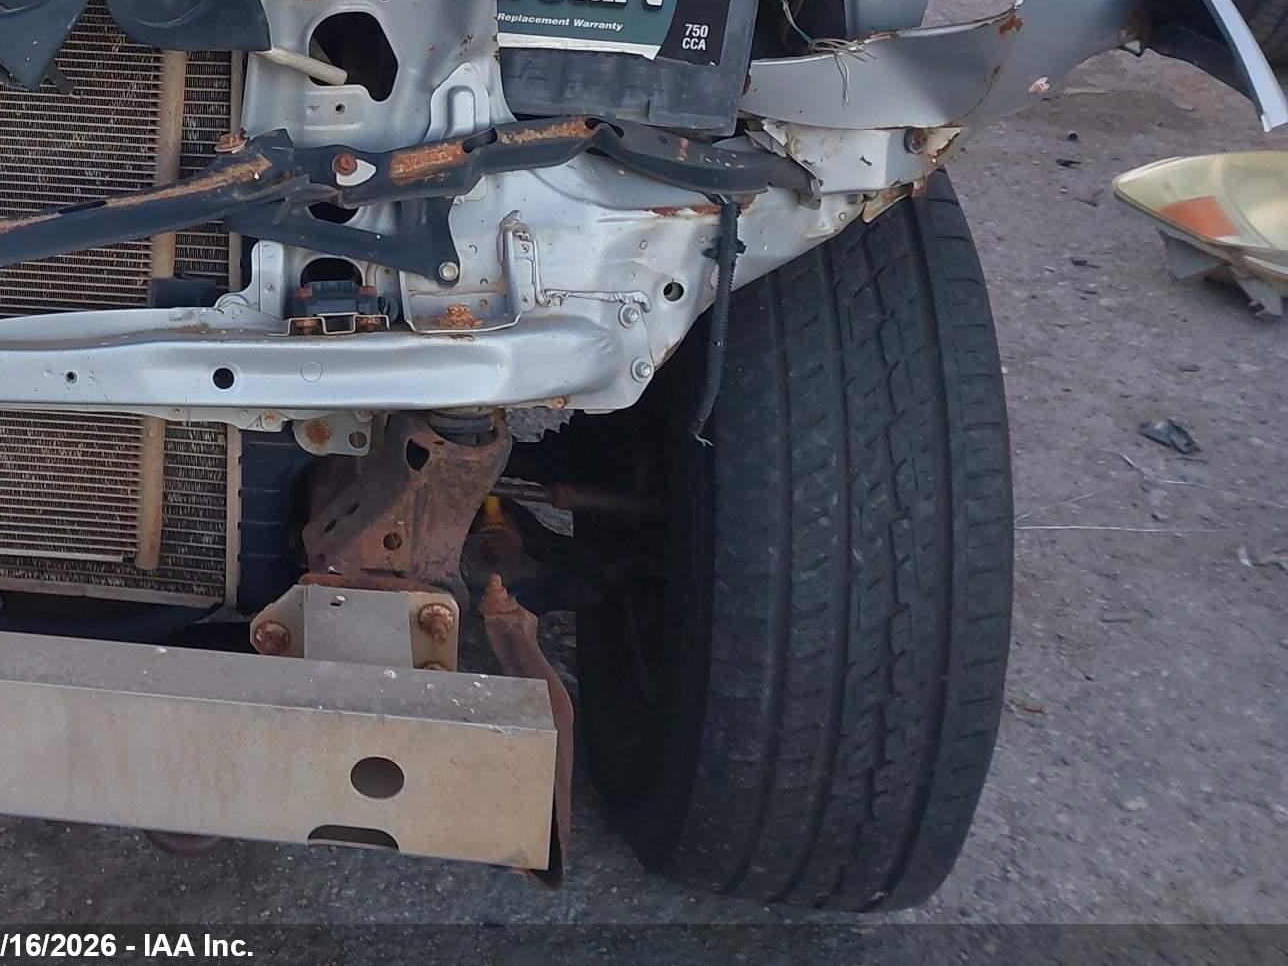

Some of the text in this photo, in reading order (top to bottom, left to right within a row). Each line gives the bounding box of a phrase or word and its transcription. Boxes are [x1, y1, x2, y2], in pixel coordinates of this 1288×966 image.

[497, 12, 623, 32] Replacement Warranty
[684, 23, 709, 38] 750
[682, 37, 707, 51] CCA
